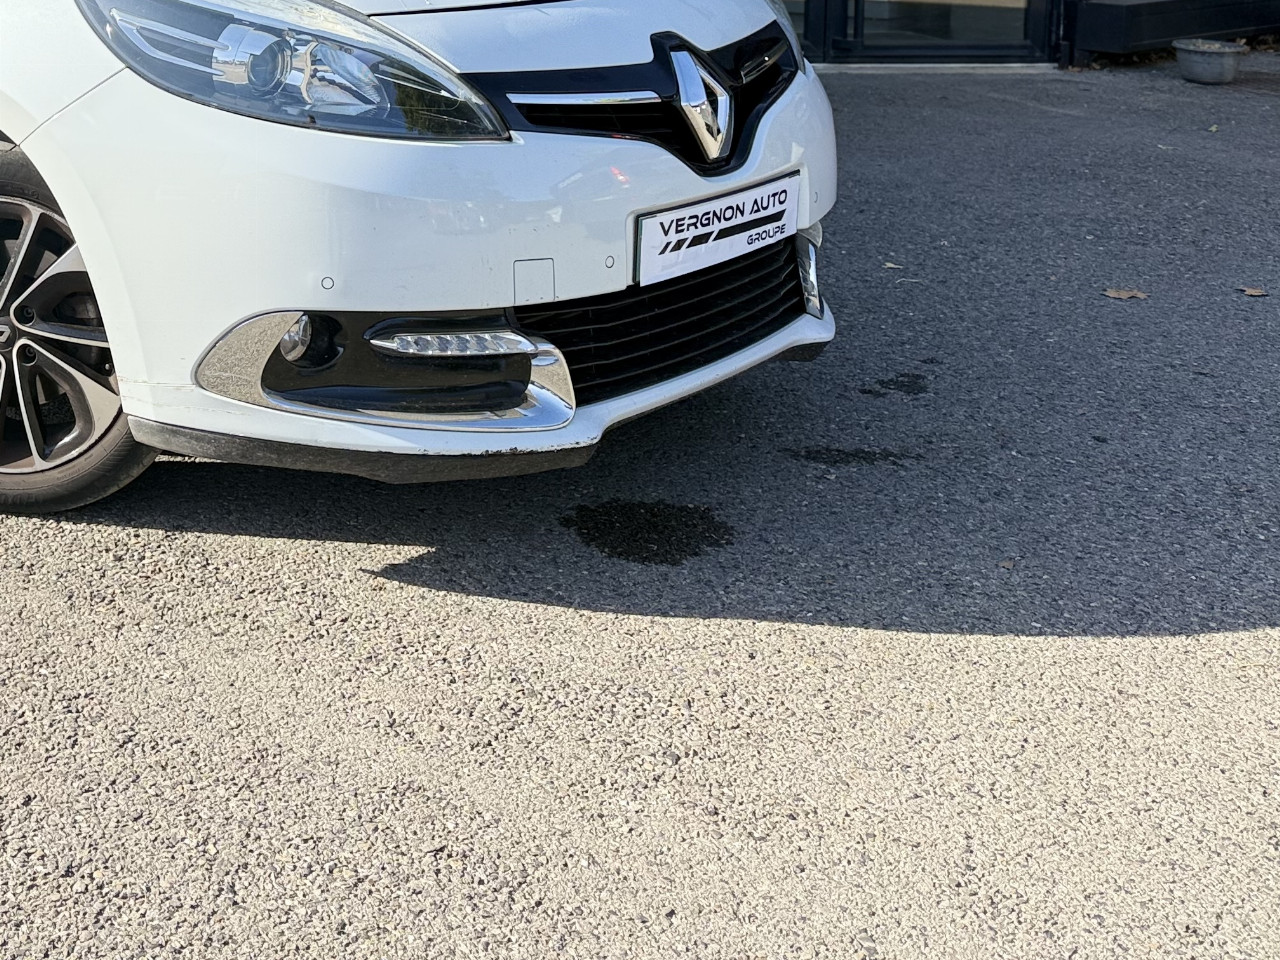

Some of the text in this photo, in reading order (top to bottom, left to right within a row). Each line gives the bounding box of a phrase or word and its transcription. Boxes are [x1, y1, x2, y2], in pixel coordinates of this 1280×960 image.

[659, 189, 788, 237] VERGNON AUTO
[747, 223, 787, 246] GROUPE
